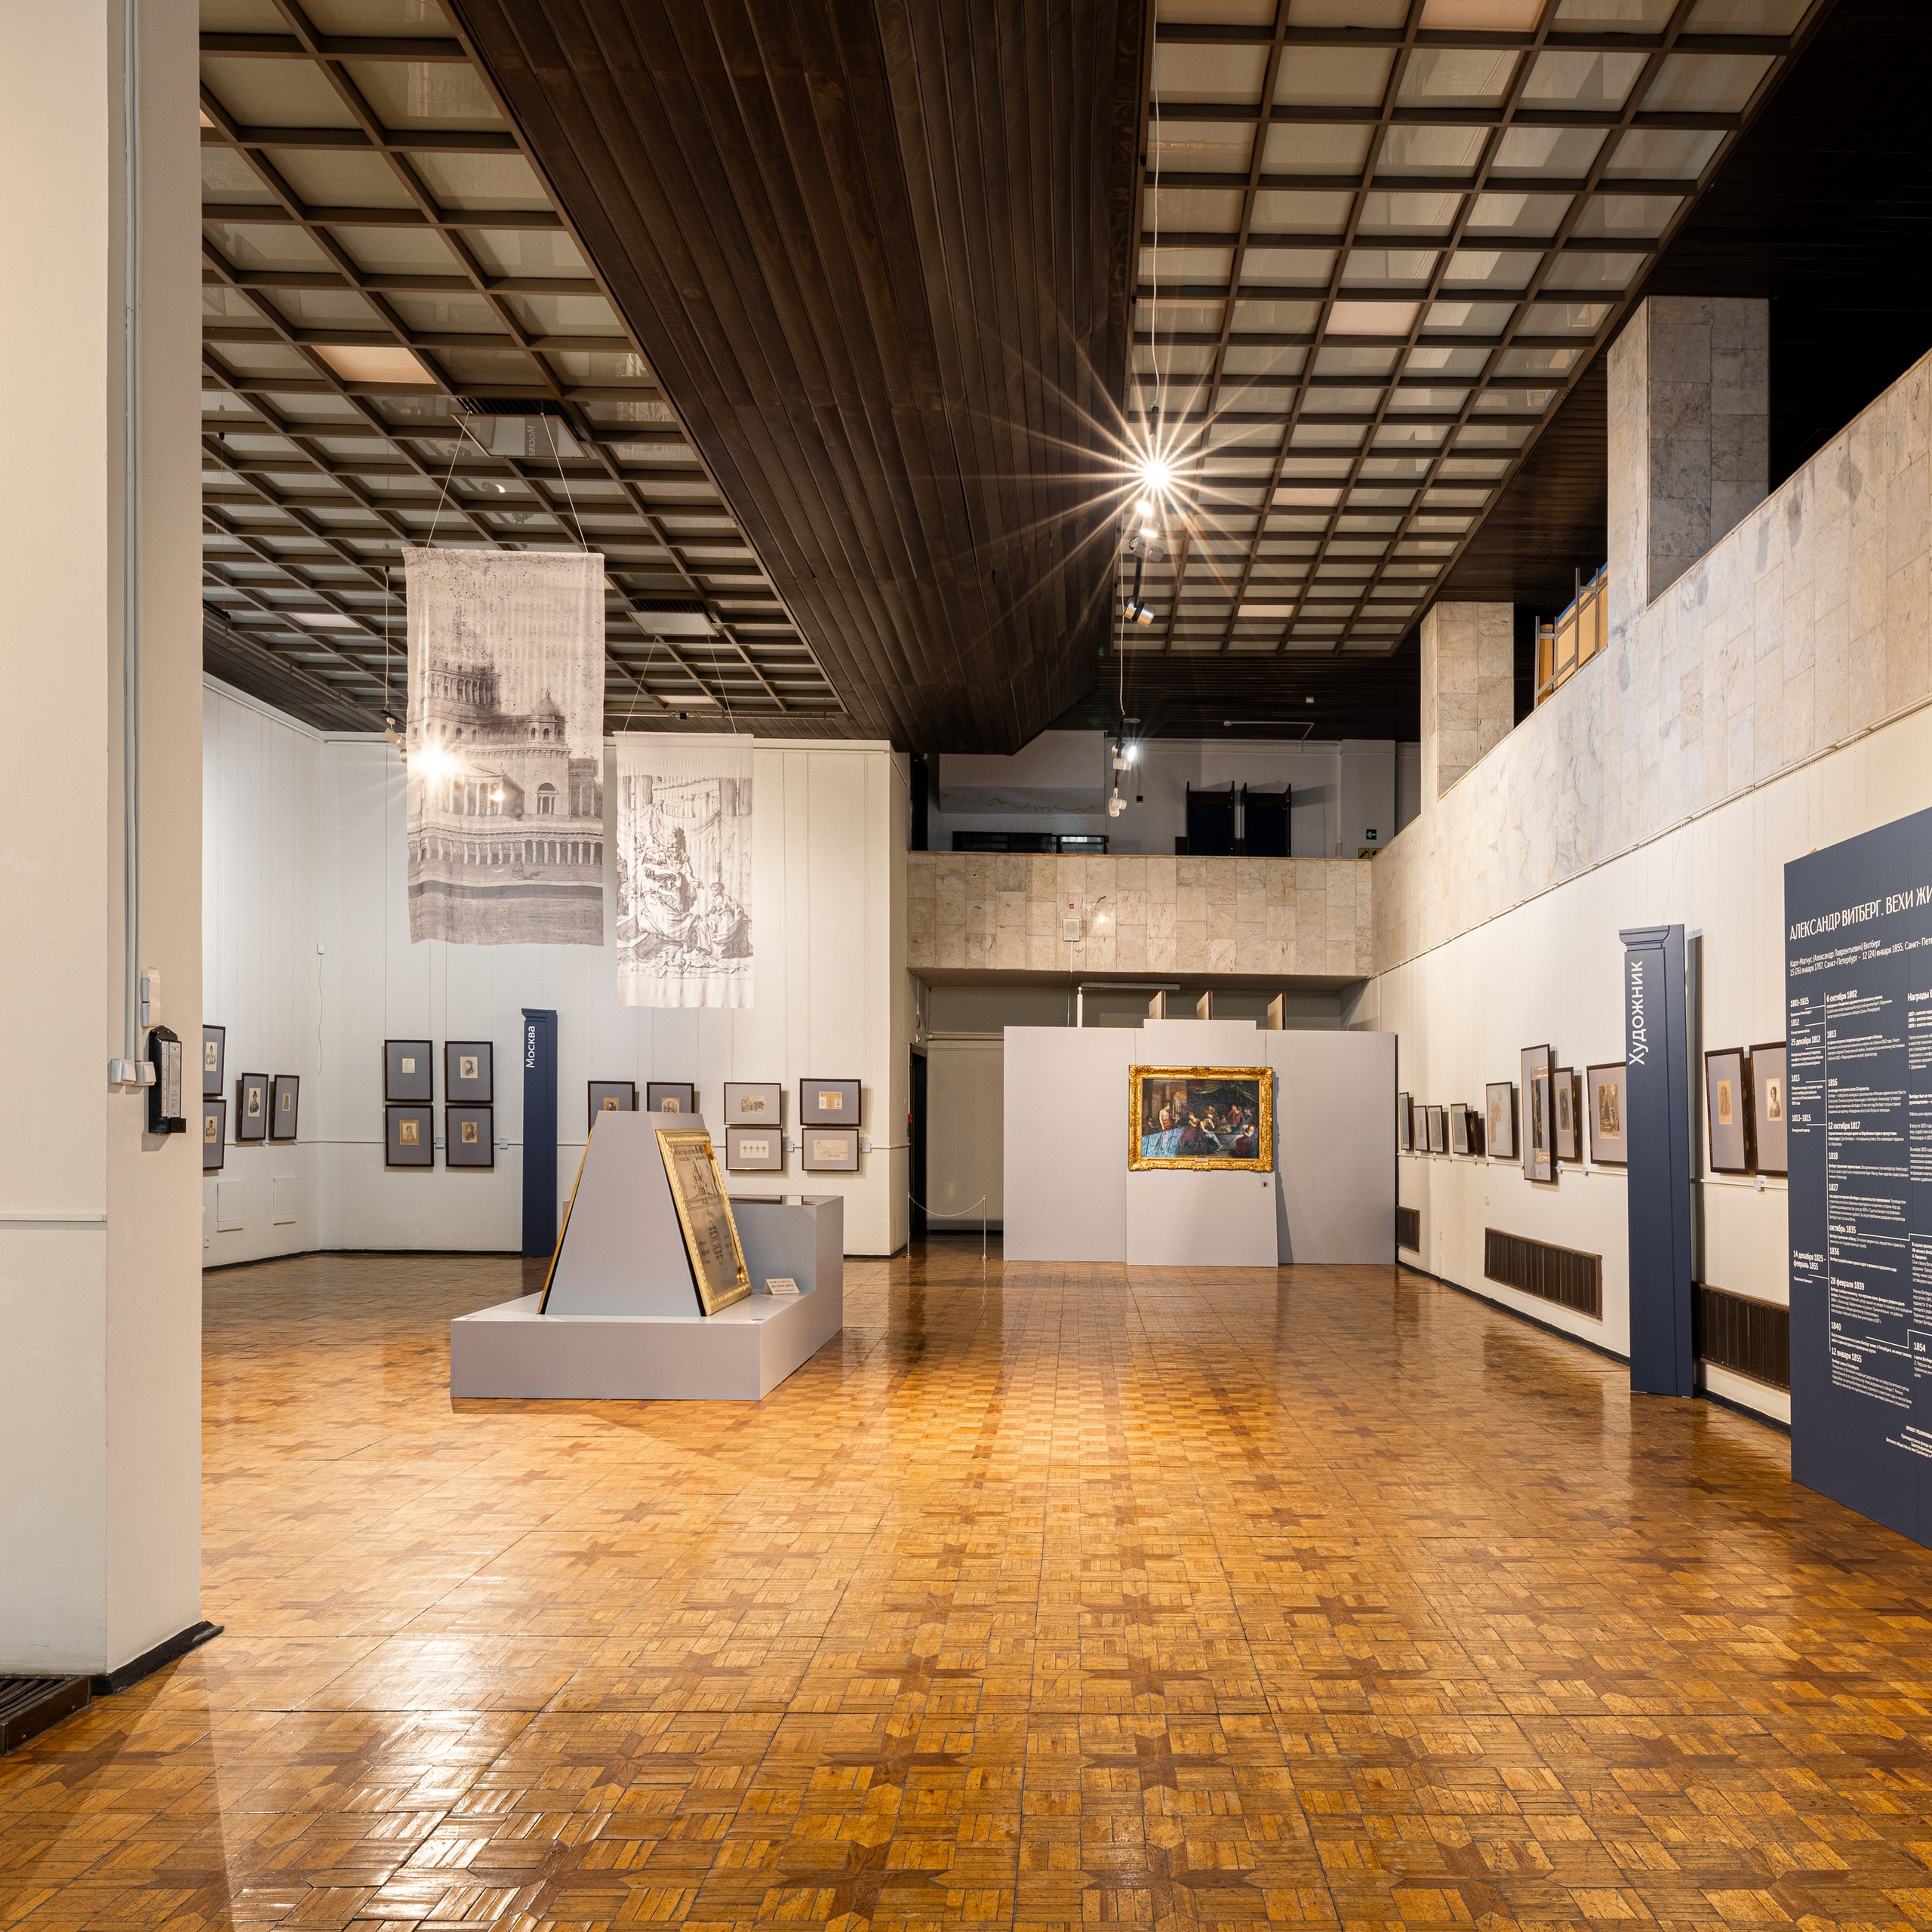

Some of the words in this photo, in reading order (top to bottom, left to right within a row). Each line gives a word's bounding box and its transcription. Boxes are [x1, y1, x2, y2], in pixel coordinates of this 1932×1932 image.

[1789, 912, 1841, 941] АЛЕКСАНДР
[1841, 900, 1884, 927] ВИТБЕРГ.
[1885, 890, 1914, 915] ВЕХИ
[1789, 956, 1813, 968] Карл-Магнус
[1813, 952, 1834, 963] (Александр
[1834, 943, 1863, 957] Лаврентьевич)
[1863, 940, 1881, 950] Витберг
[1801, 965, 1814, 974] января
[1823, 955, 1858, 969] Санкт-Петербург
[1862, 951, 1867, 960] 12
[1867, 949, 1876, 960] (24)
[1876, 946, 1892, 957] января
[1826, 994, 1830, 1003] 6
[1829, 992, 1847, 1002] октября
[1907, 992, 1929, 1002] Награды
[1628, 960, 1649, 1066] Художник
[525, 1026, 536, 1069] Москва
[1795, 1036, 1811, 1047] декабря
[1828, 1121, 1833, 1130] 12
[1833, 1121, 1850, 1131] октября
[1850, 1121, 1861, 1130] 1817
[1846, 1225, 1857, 1235] 1835
[1793, 1250, 1798, 1258] 14
[1798, 1252, 1814, 1262] декабря
[1835, 1278, 1854, 1289] февраля
[1913, 1341, 1926, 1353] 1854
[1831, 1346, 1837, 1356] 12
[1836, 1349, 1852, 1361] января
[1851, 1352, 1863, 1364] 1855
